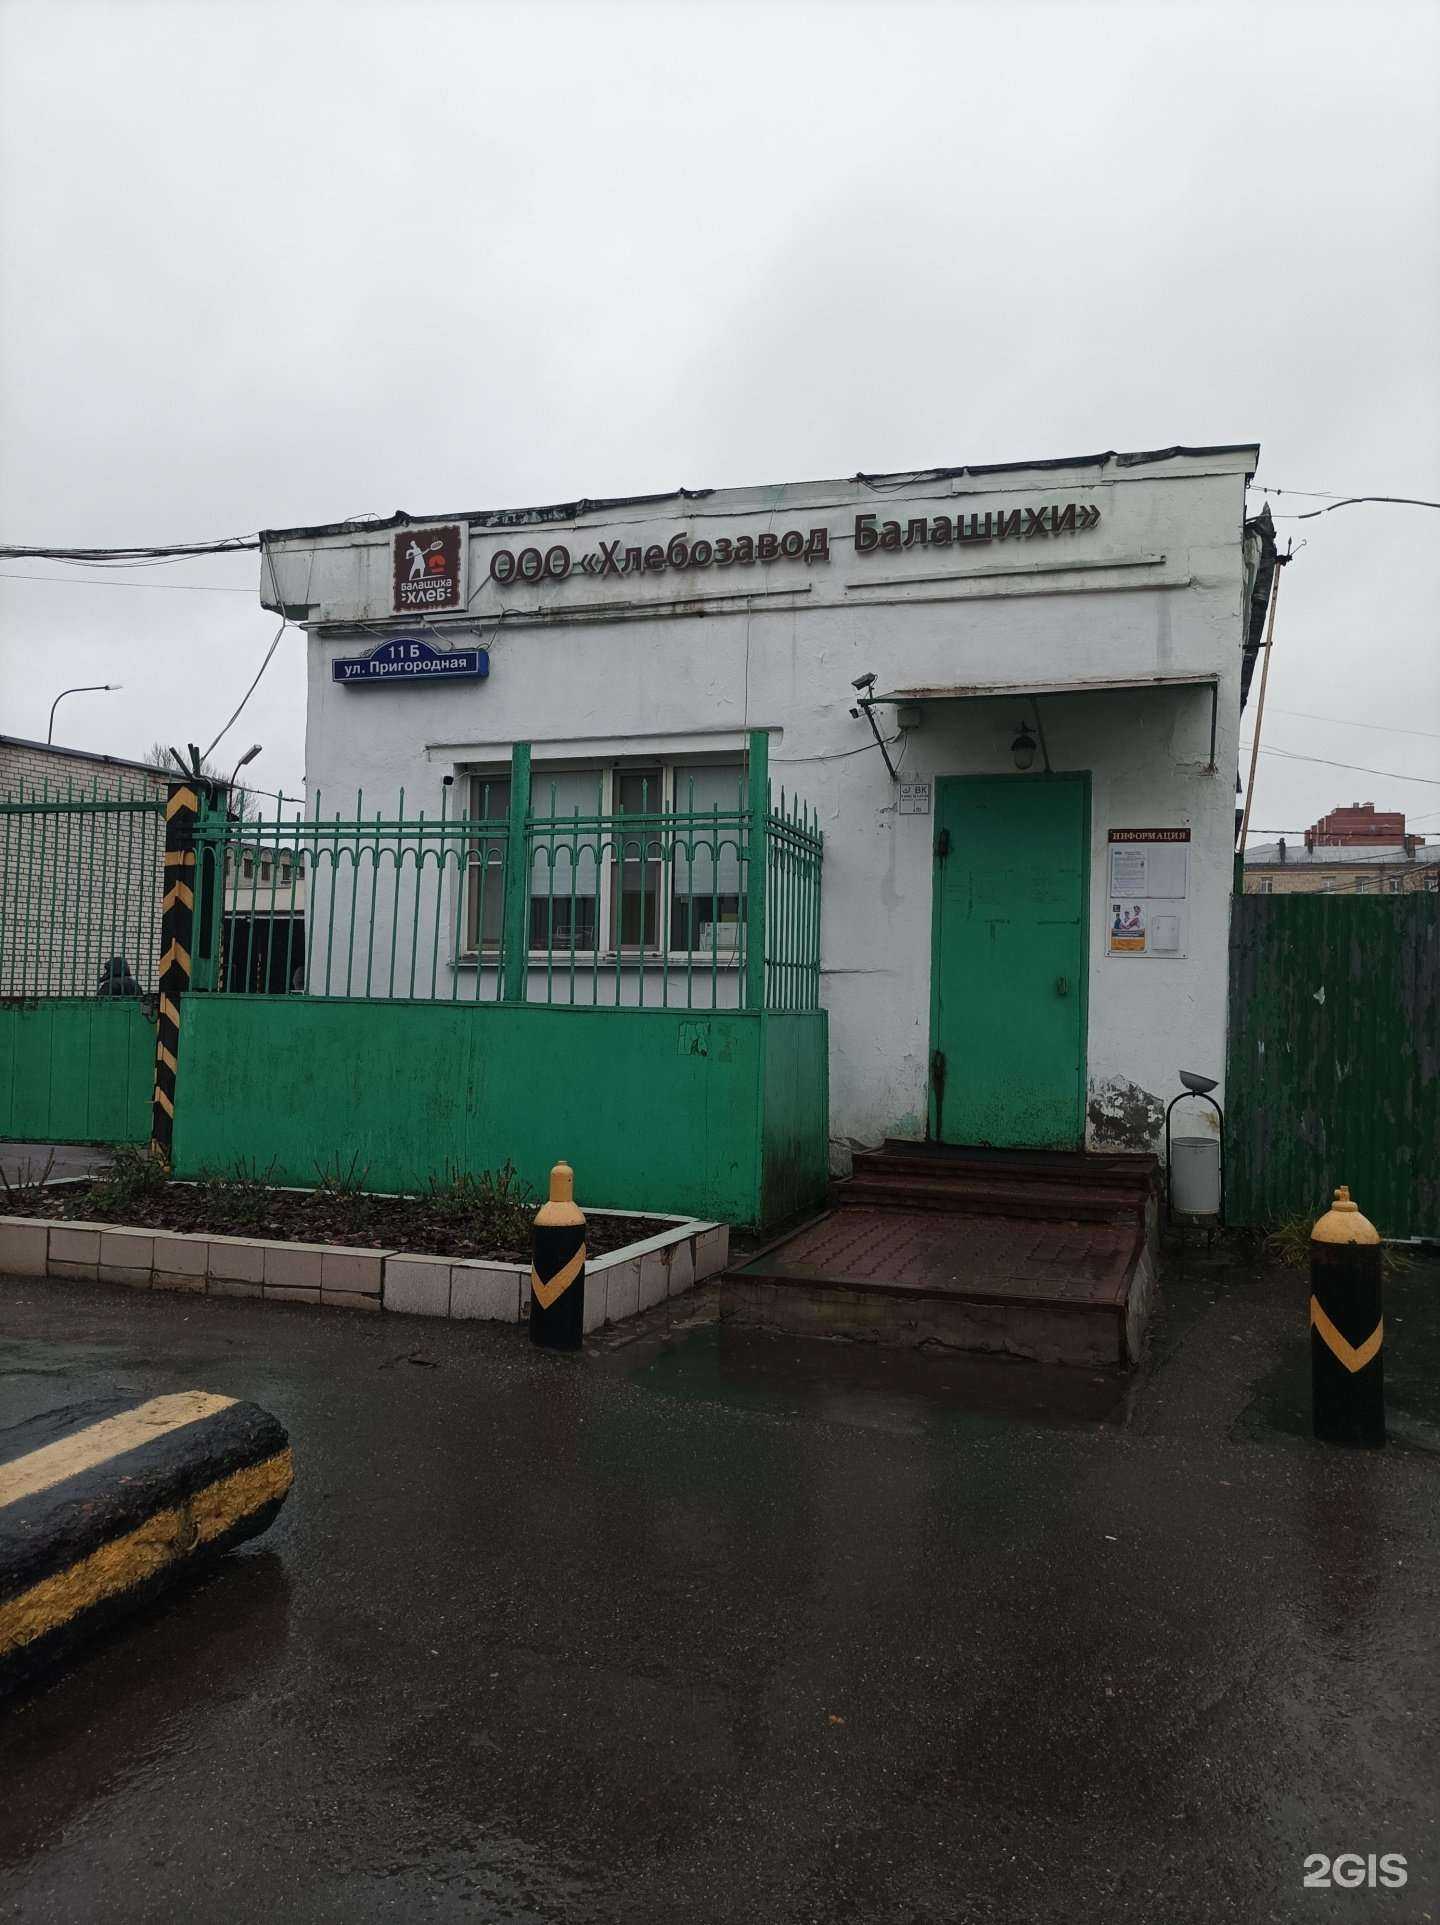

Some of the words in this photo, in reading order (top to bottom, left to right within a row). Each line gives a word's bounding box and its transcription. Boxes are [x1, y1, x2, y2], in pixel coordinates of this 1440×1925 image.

[489, 544, 573, 584] ООО
[579, 527, 830, 578] «Хлебозавод
[854, 503, 1102, 552] Балашихи»
[389, 645, 405, 659] 11
[410, 645, 420, 658] Б
[344, 664, 366, 676] ул.
[370, 658, 467, 675] Пригородная
[1112, 830, 1187, 841] ИНФОРМАЦИЯ
